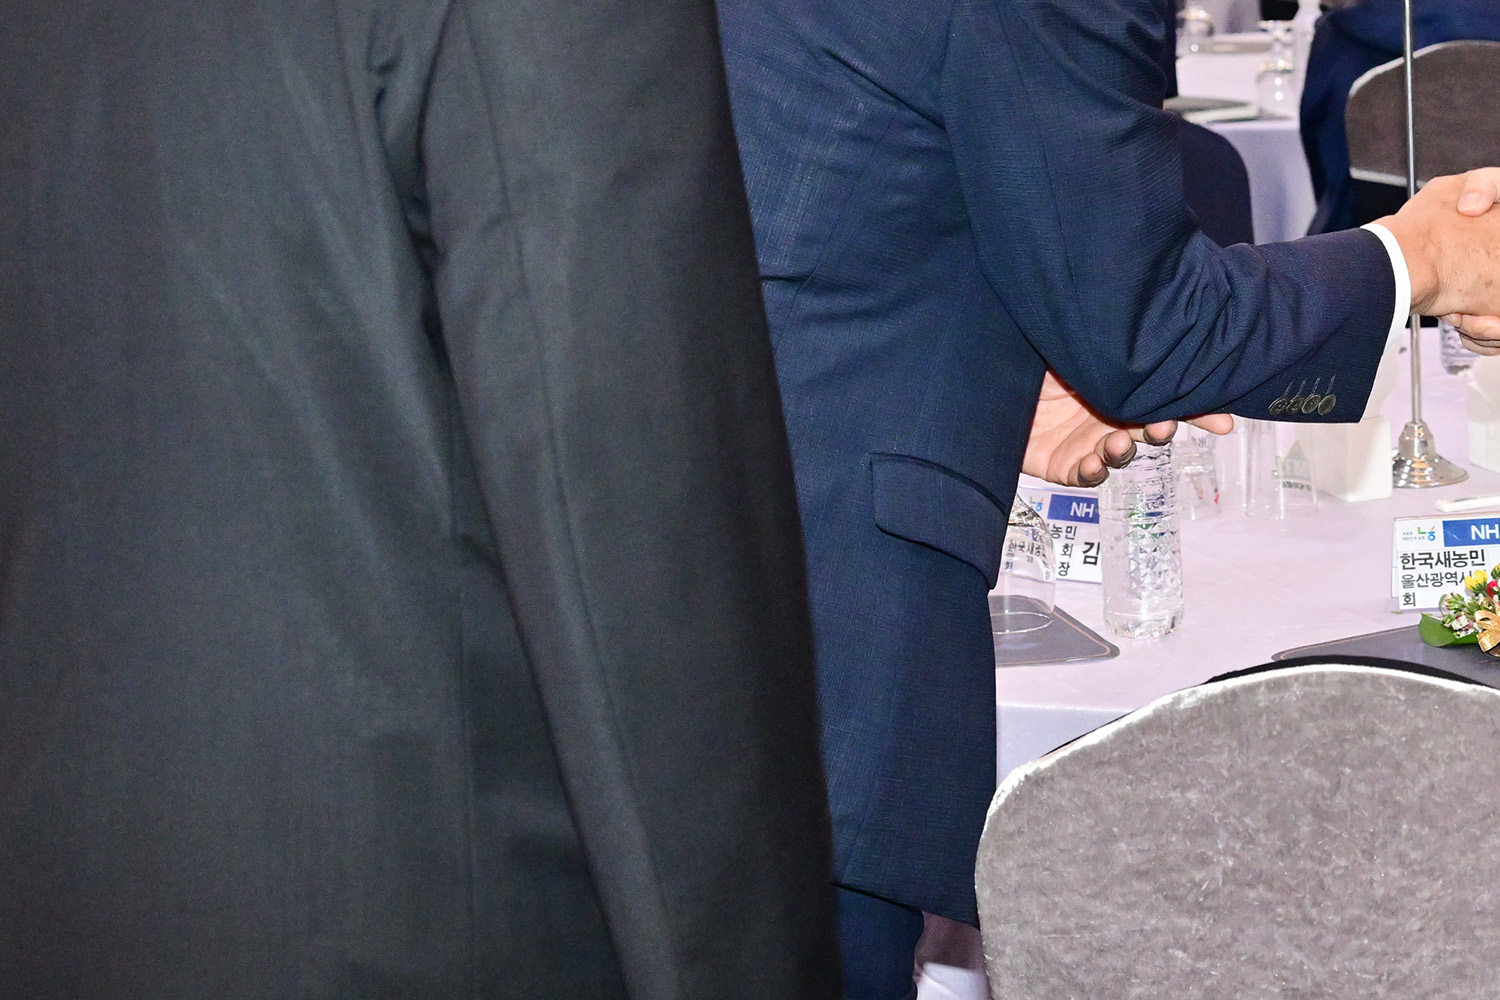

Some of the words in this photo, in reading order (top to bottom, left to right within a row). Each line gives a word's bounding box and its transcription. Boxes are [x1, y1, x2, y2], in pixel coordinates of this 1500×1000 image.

[1070, 501, 1095, 518] NH
[1470, 523, 1500, 541] NH
[1400, 549, 1486, 571] 한국새농민
[1402, 592, 1416, 608] 회
